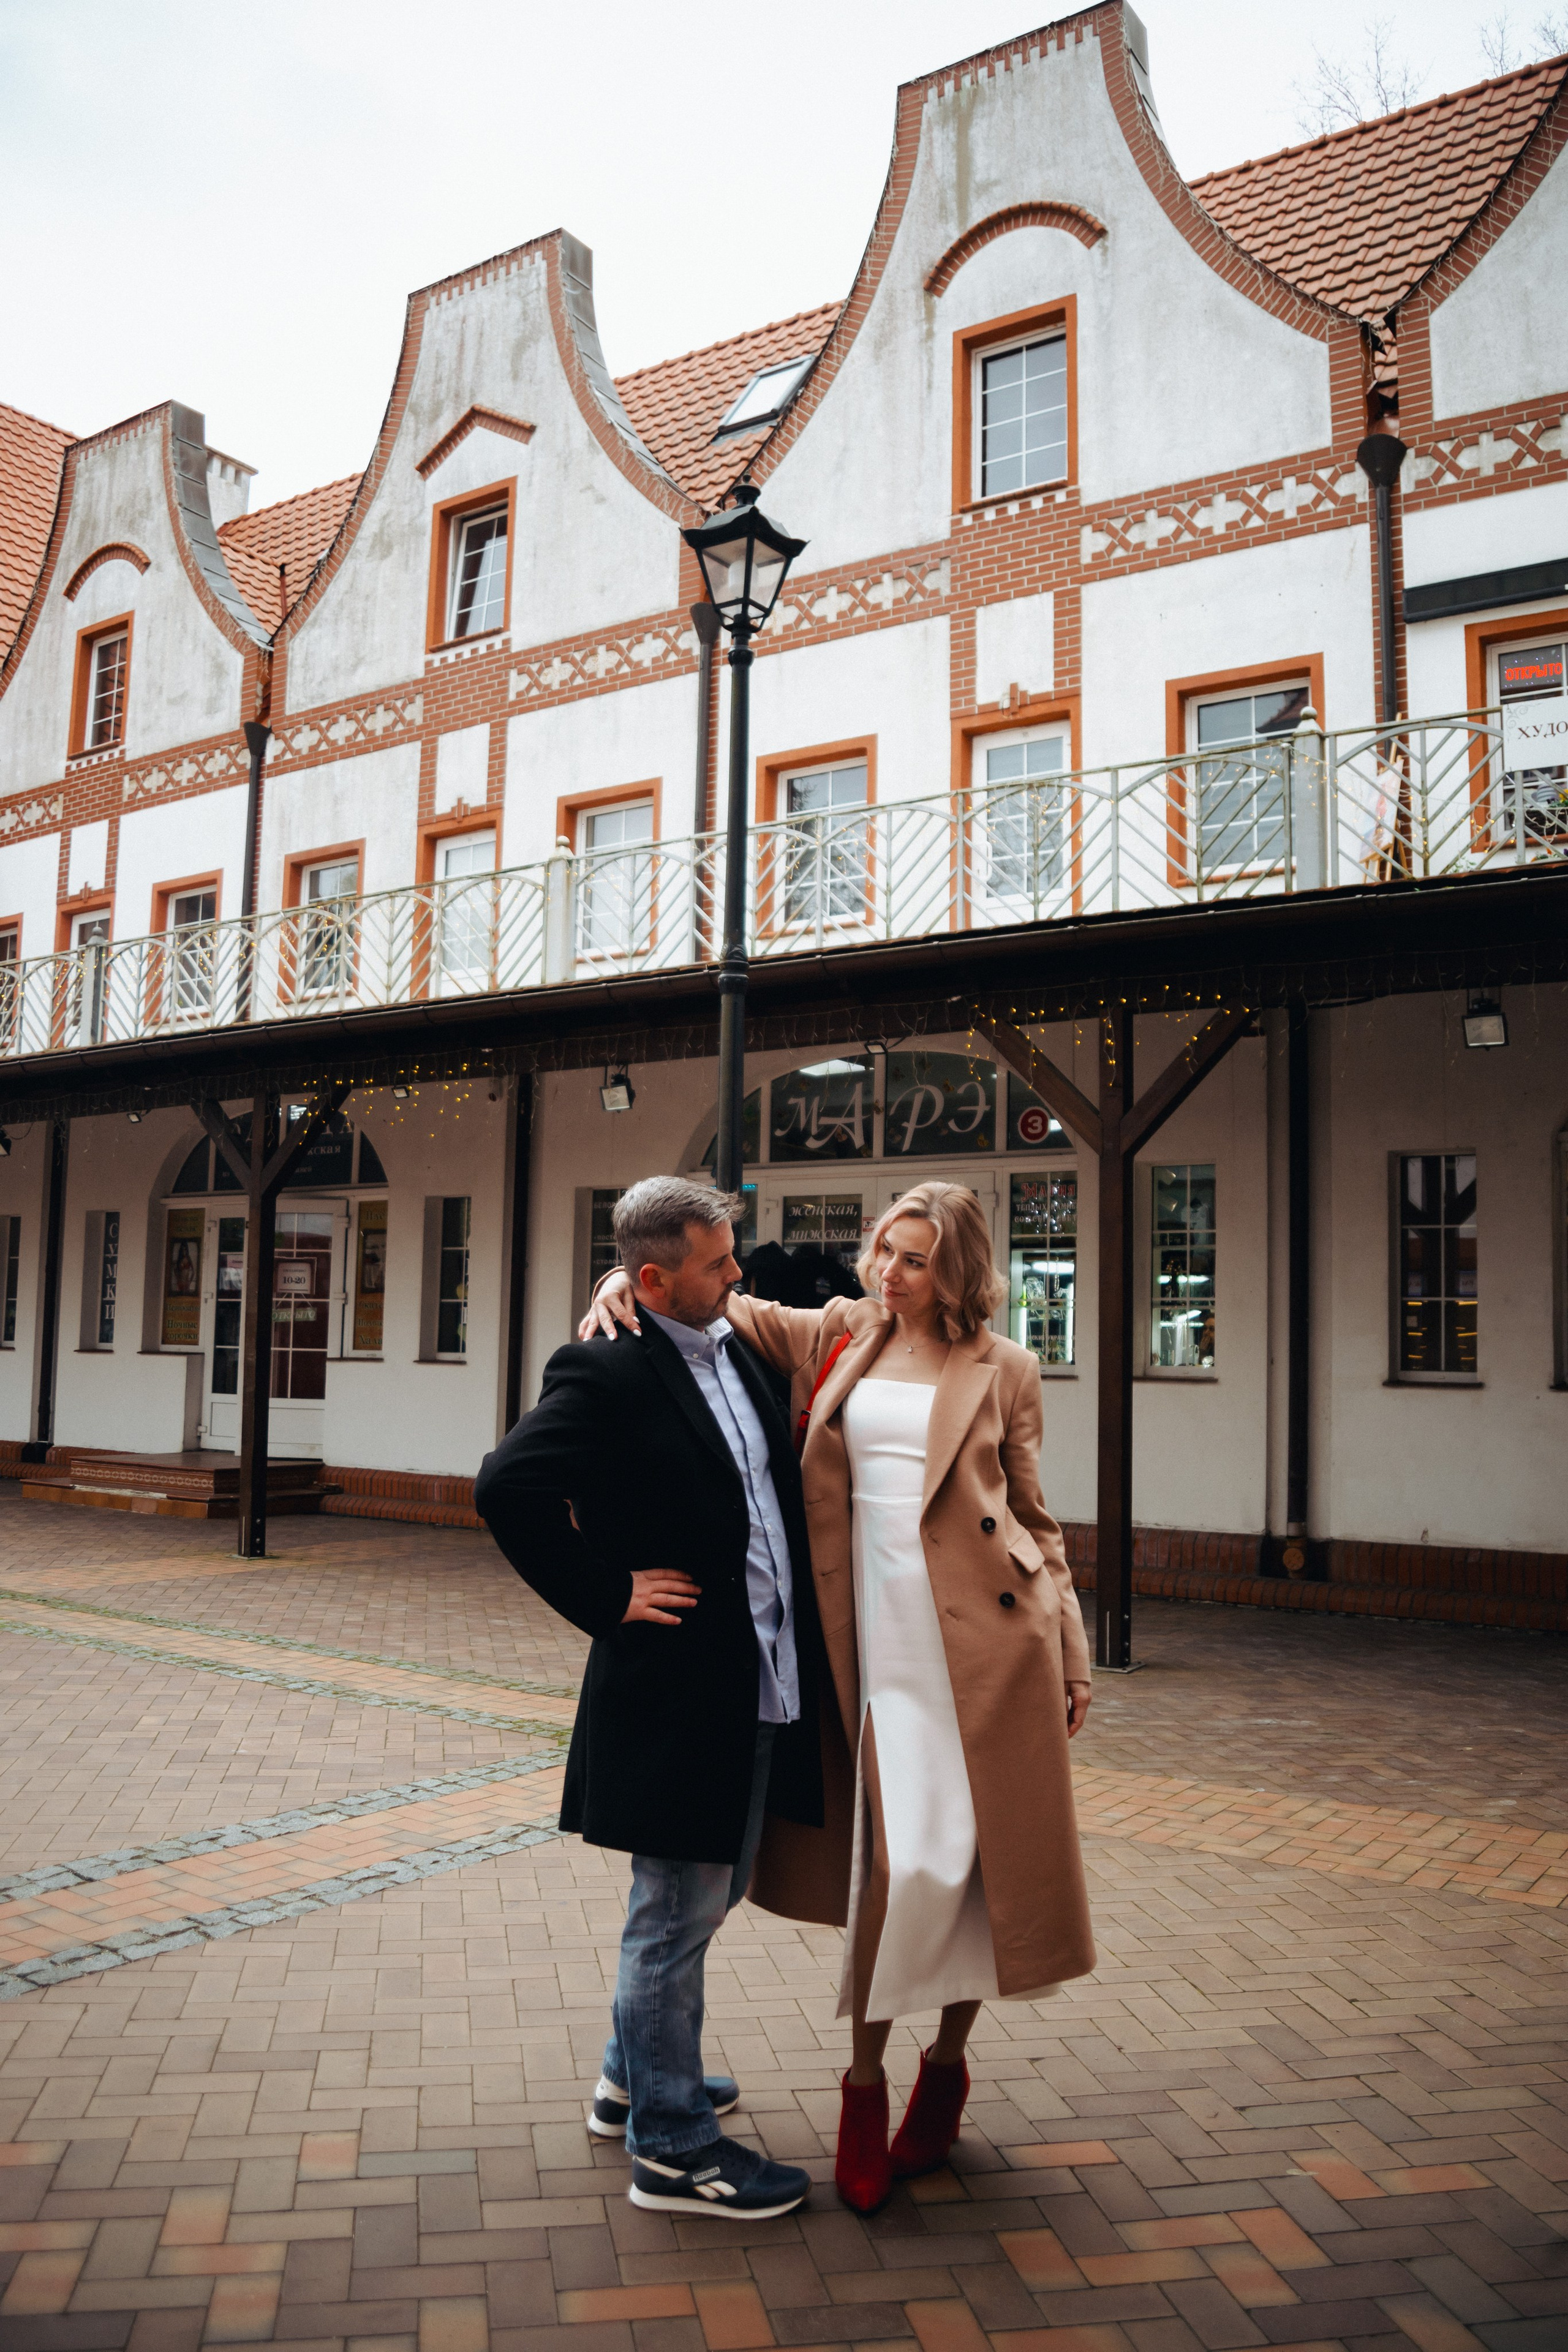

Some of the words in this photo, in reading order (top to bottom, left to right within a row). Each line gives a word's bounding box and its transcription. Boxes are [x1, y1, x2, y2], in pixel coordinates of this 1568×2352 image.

[1505, 663, 1563, 681] ОТКРЫТО
[1028, 1115, 1043, 1134] 3
[789, 1204, 858, 1217] женская,
[788, 1228, 858, 1240] мужская
[694, 2167, 719, 2180] Reebok
